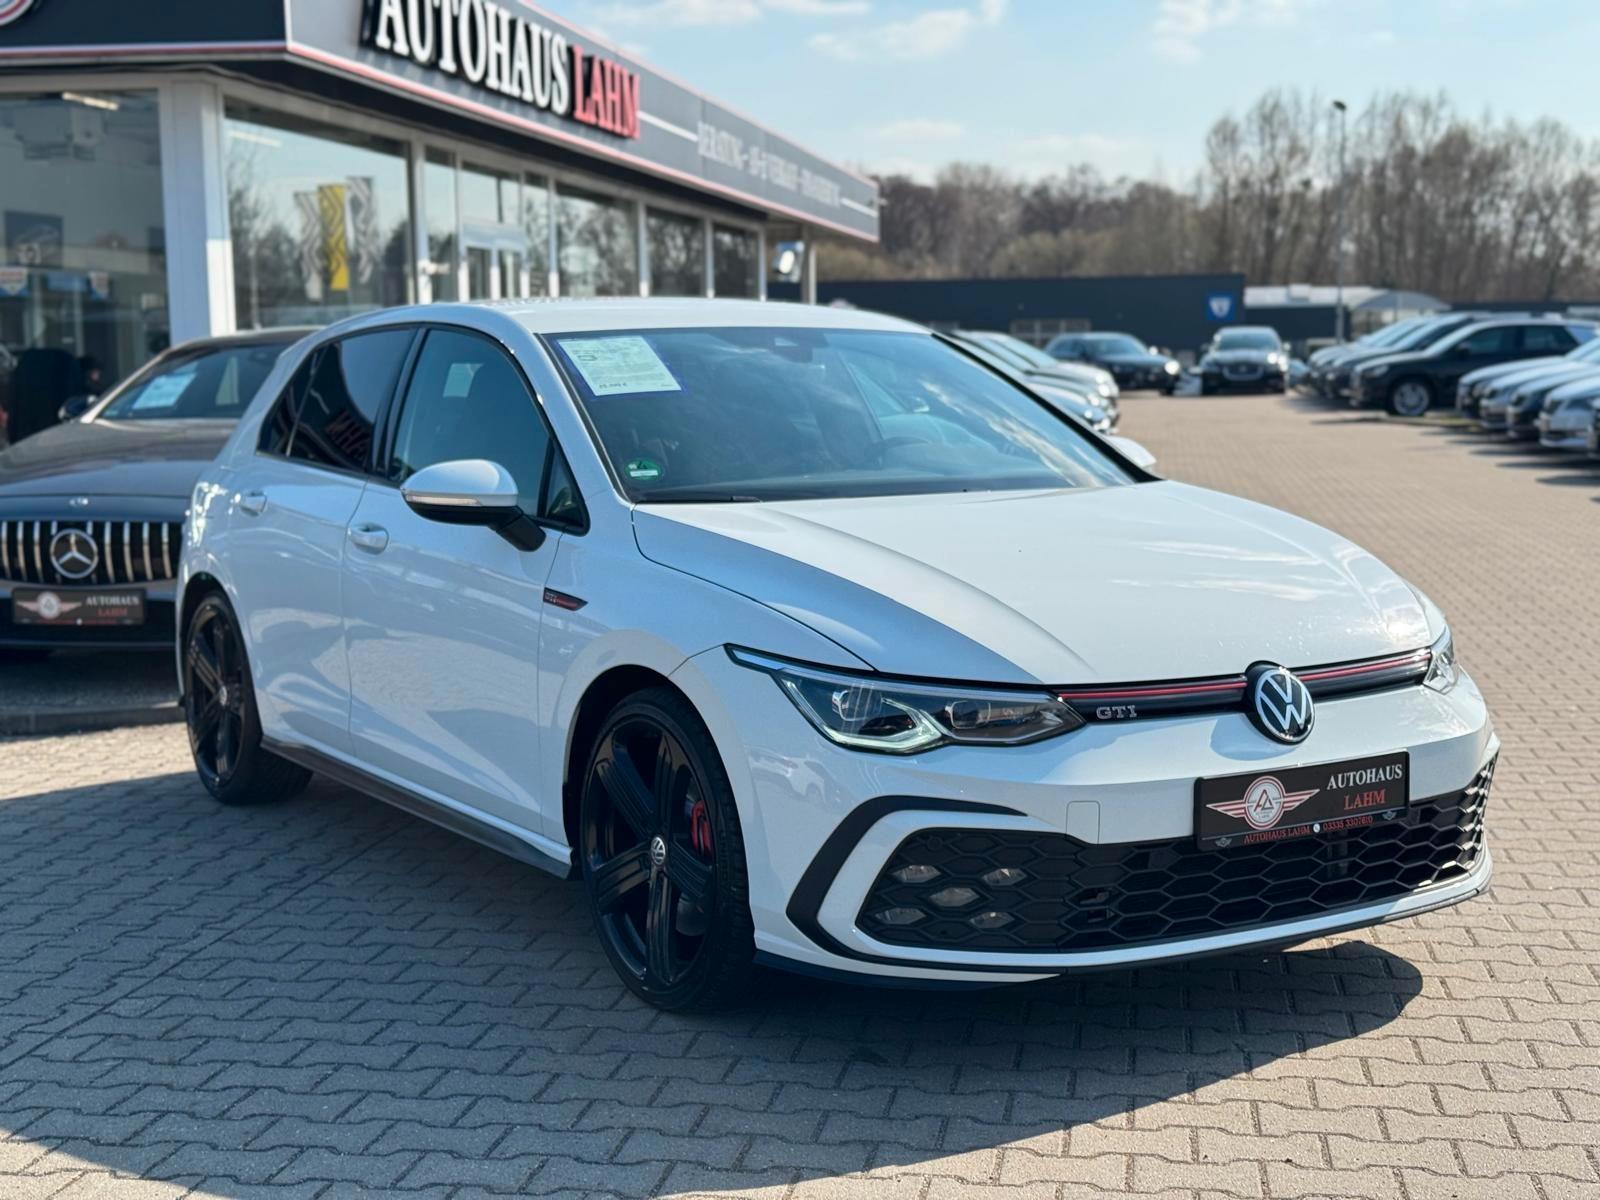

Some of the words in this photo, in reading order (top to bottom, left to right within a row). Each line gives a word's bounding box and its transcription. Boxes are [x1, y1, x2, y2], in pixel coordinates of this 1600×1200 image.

[375, 0, 570, 115] AUTOHAUS
[572, 45, 640, 139] LAHM
[86, 595, 139, 606] AUTOHAUS
[1096, 704, 1138, 720] GTI
[1326, 763, 1403, 790] AUTOHAUS
[1343, 788, 1387, 811] LAHM
[1243, 828, 1287, 845] AUTOHAUS
[1287, 825, 1311, 838] LAHM
